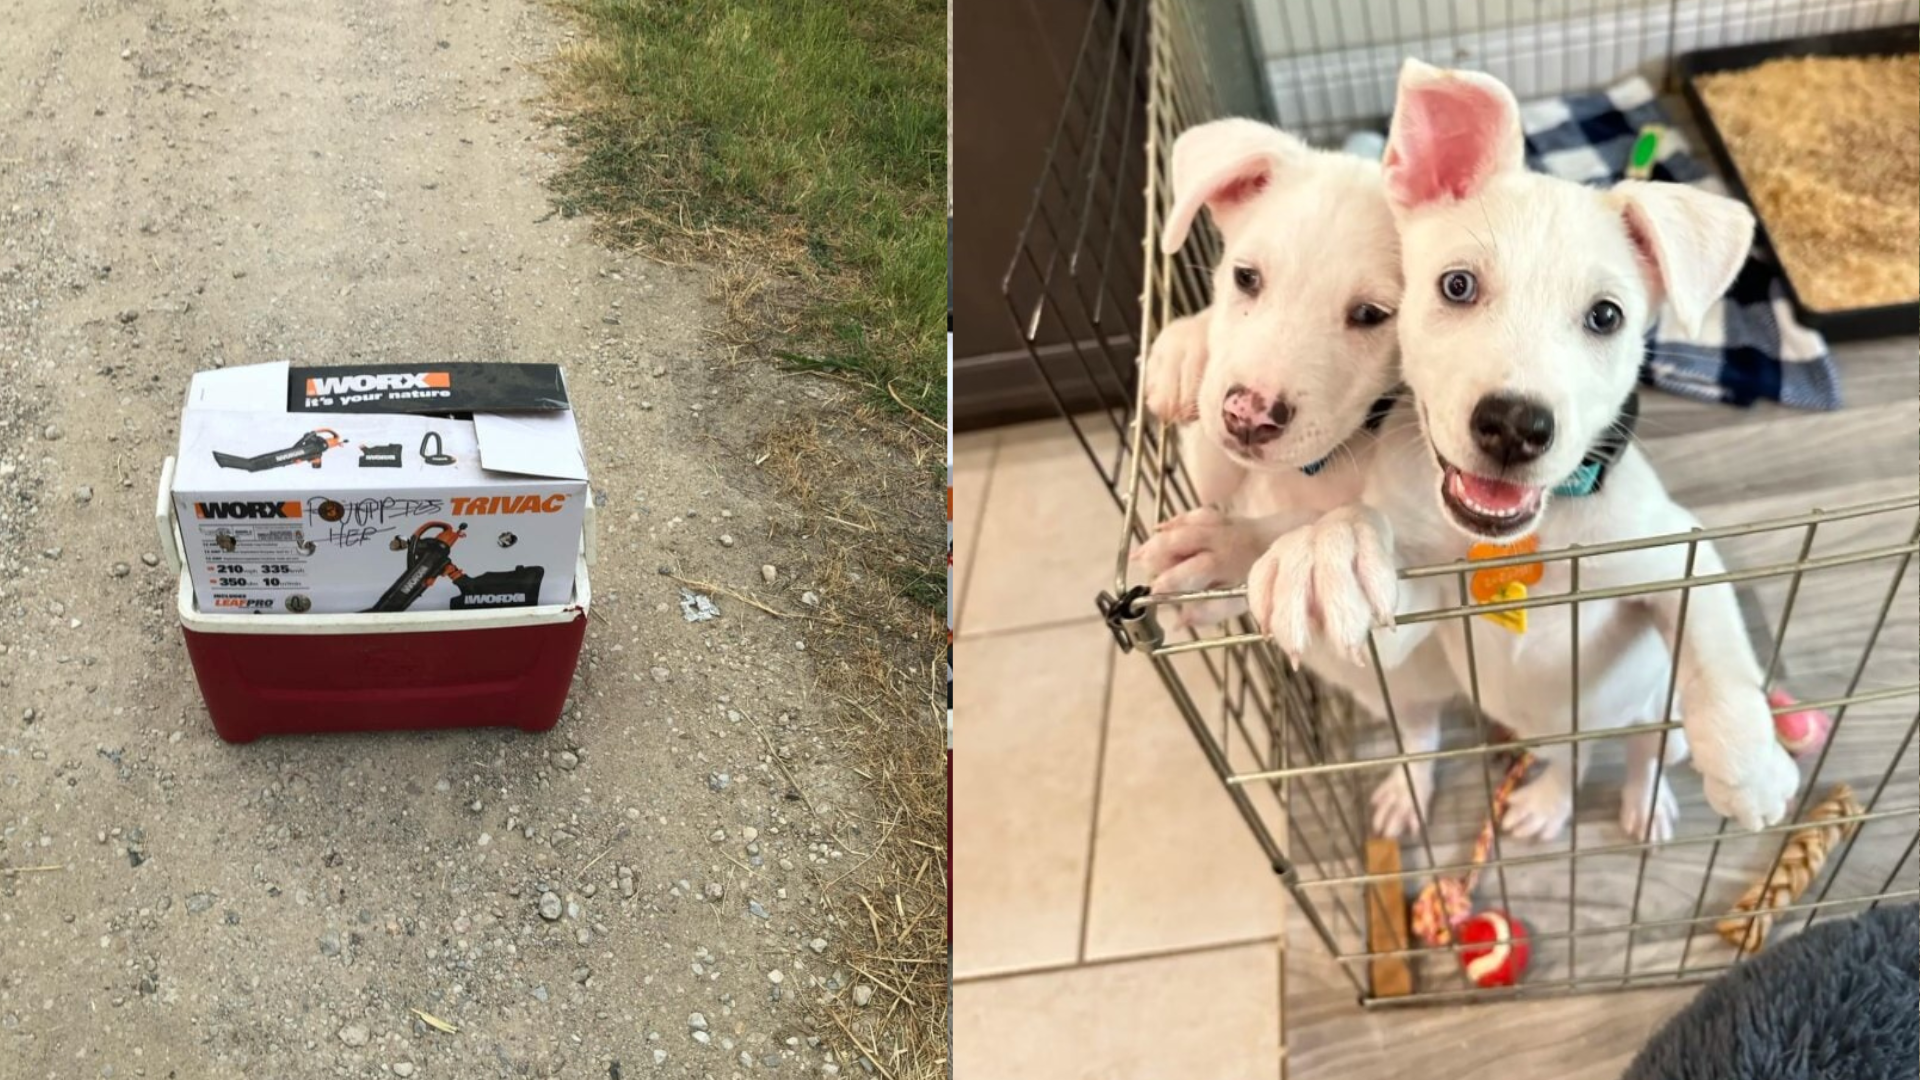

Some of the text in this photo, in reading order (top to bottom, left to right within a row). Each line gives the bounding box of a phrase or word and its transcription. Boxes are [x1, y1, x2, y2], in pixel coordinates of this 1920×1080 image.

[311, 373, 430, 395] WORX
[305, 389, 451, 408] it's your nature
[199, 501, 288, 519] WORX
[450, 493, 566, 516] TRIVAC
[217, 564, 244, 574] 210
[261, 564, 289, 574] 335
[219, 577, 247, 587] 350
[263, 577, 280, 587] 10
